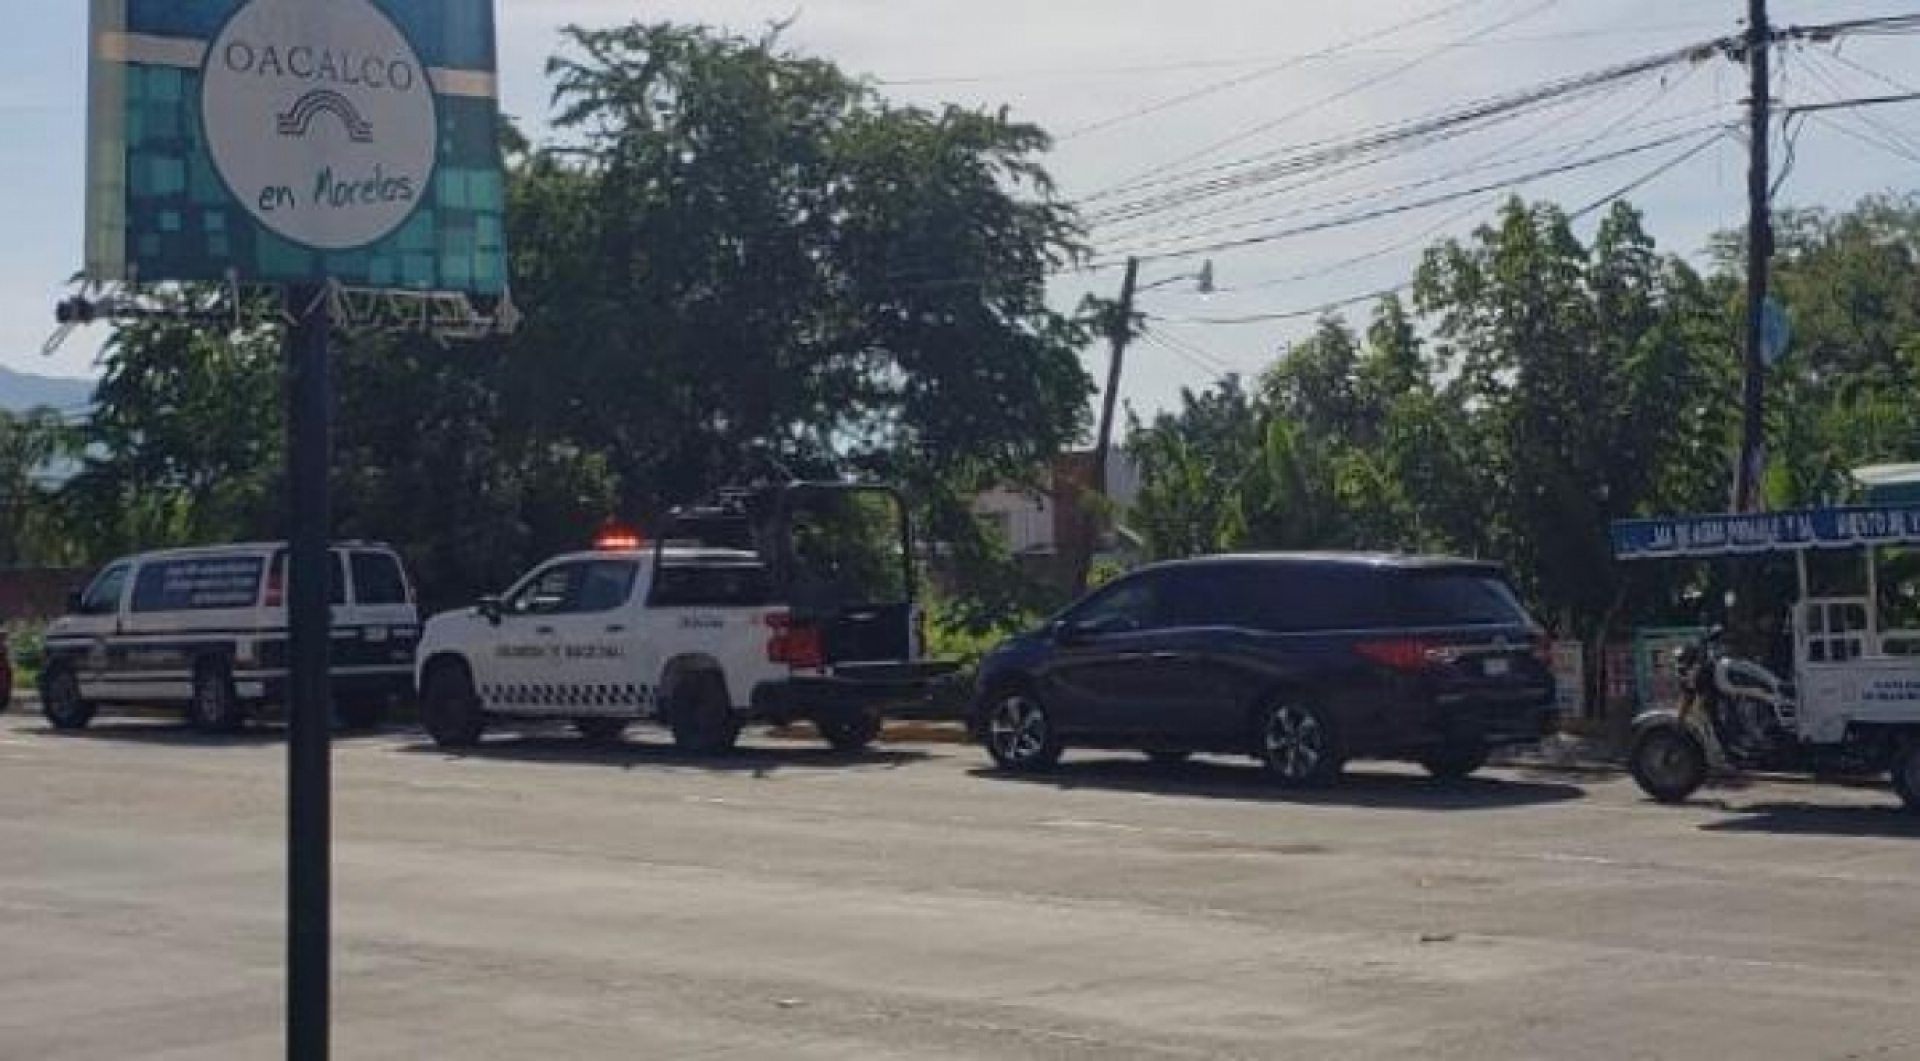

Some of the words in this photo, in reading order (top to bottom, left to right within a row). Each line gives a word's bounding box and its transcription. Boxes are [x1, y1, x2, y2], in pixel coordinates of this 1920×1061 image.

[224, 44, 413, 91] OACALCO
[258, 185, 295, 211] en
[314, 164, 413, 208] Morelos
